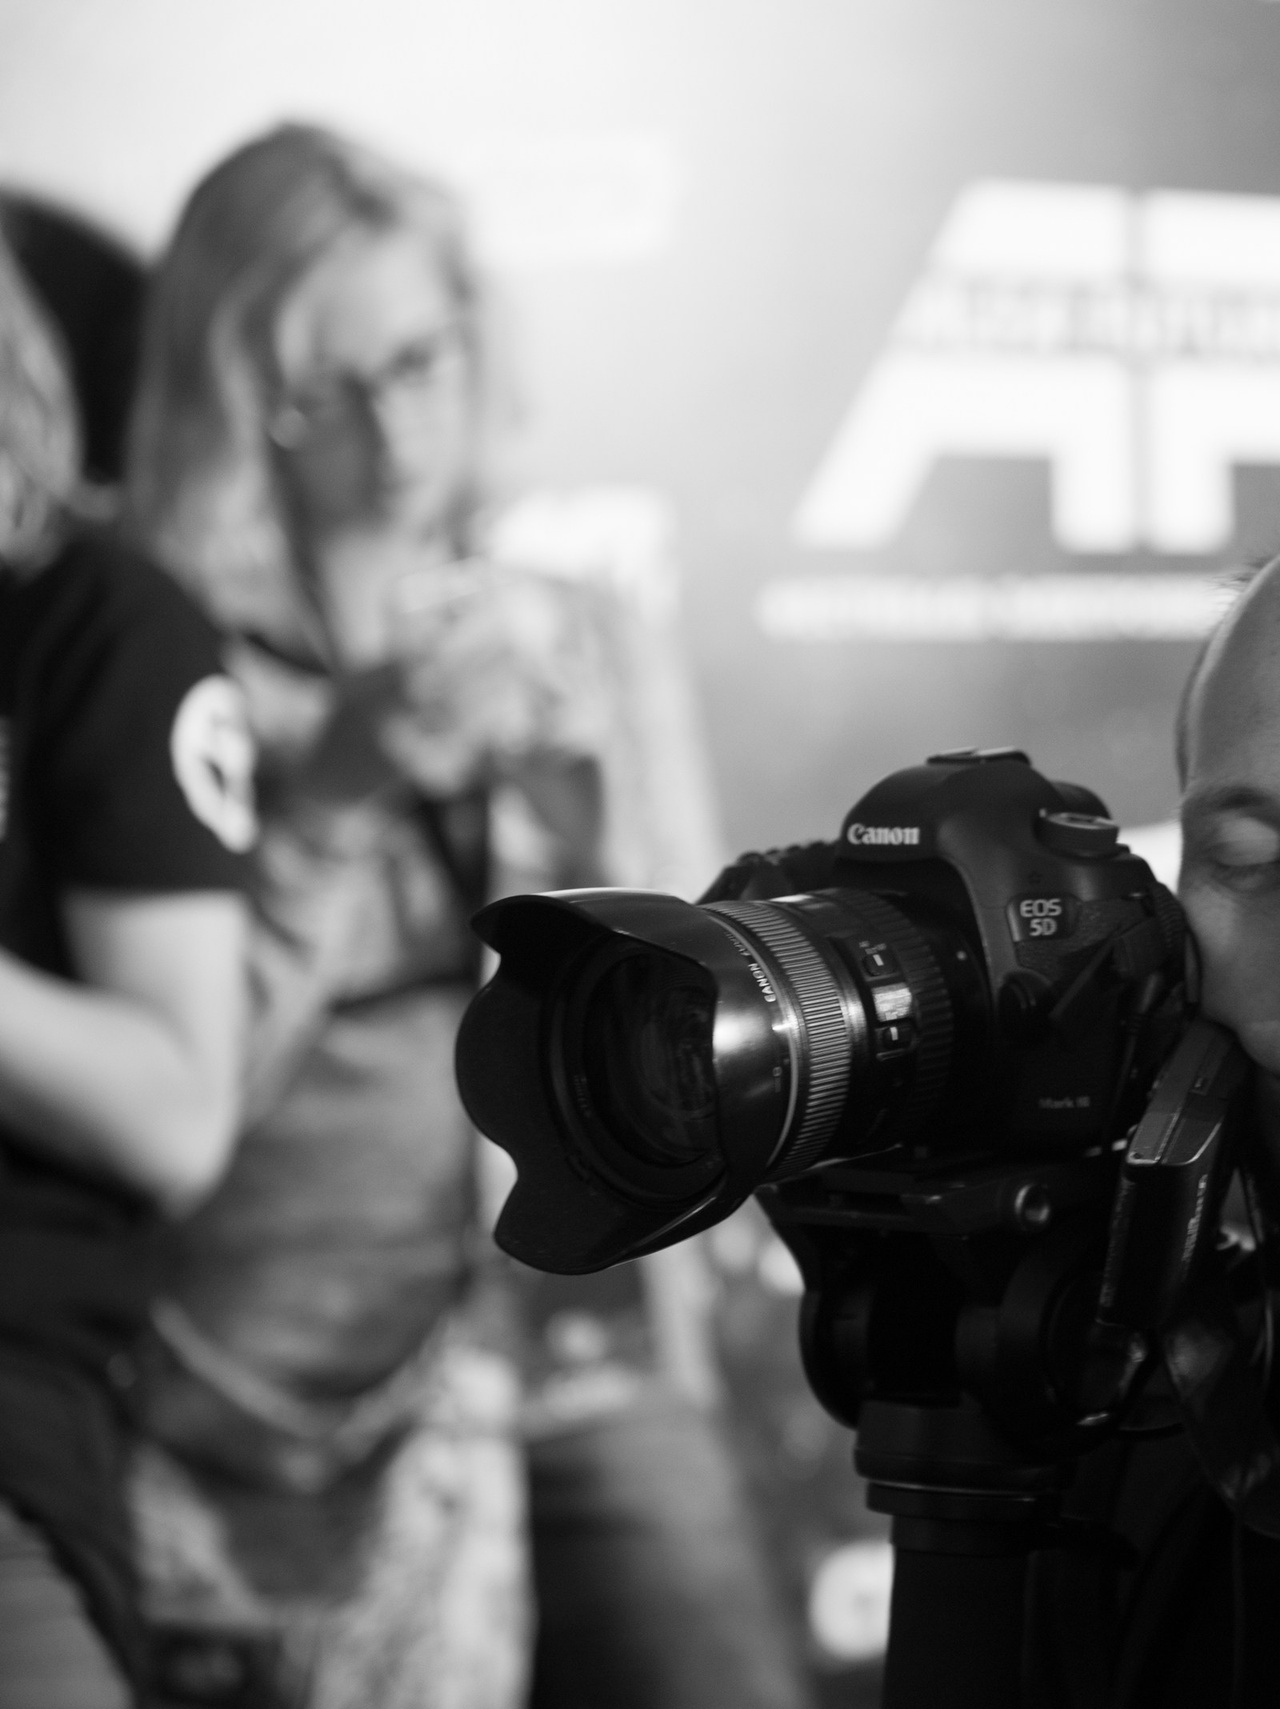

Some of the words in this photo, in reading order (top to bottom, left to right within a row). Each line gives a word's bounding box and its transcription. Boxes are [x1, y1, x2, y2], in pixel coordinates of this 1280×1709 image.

[847, 823, 919, 845] Canon
[1020, 898, 1062, 917] EOS
[1029, 918, 1057, 936] 5D
[747, 963, 777, 1003] CANON
